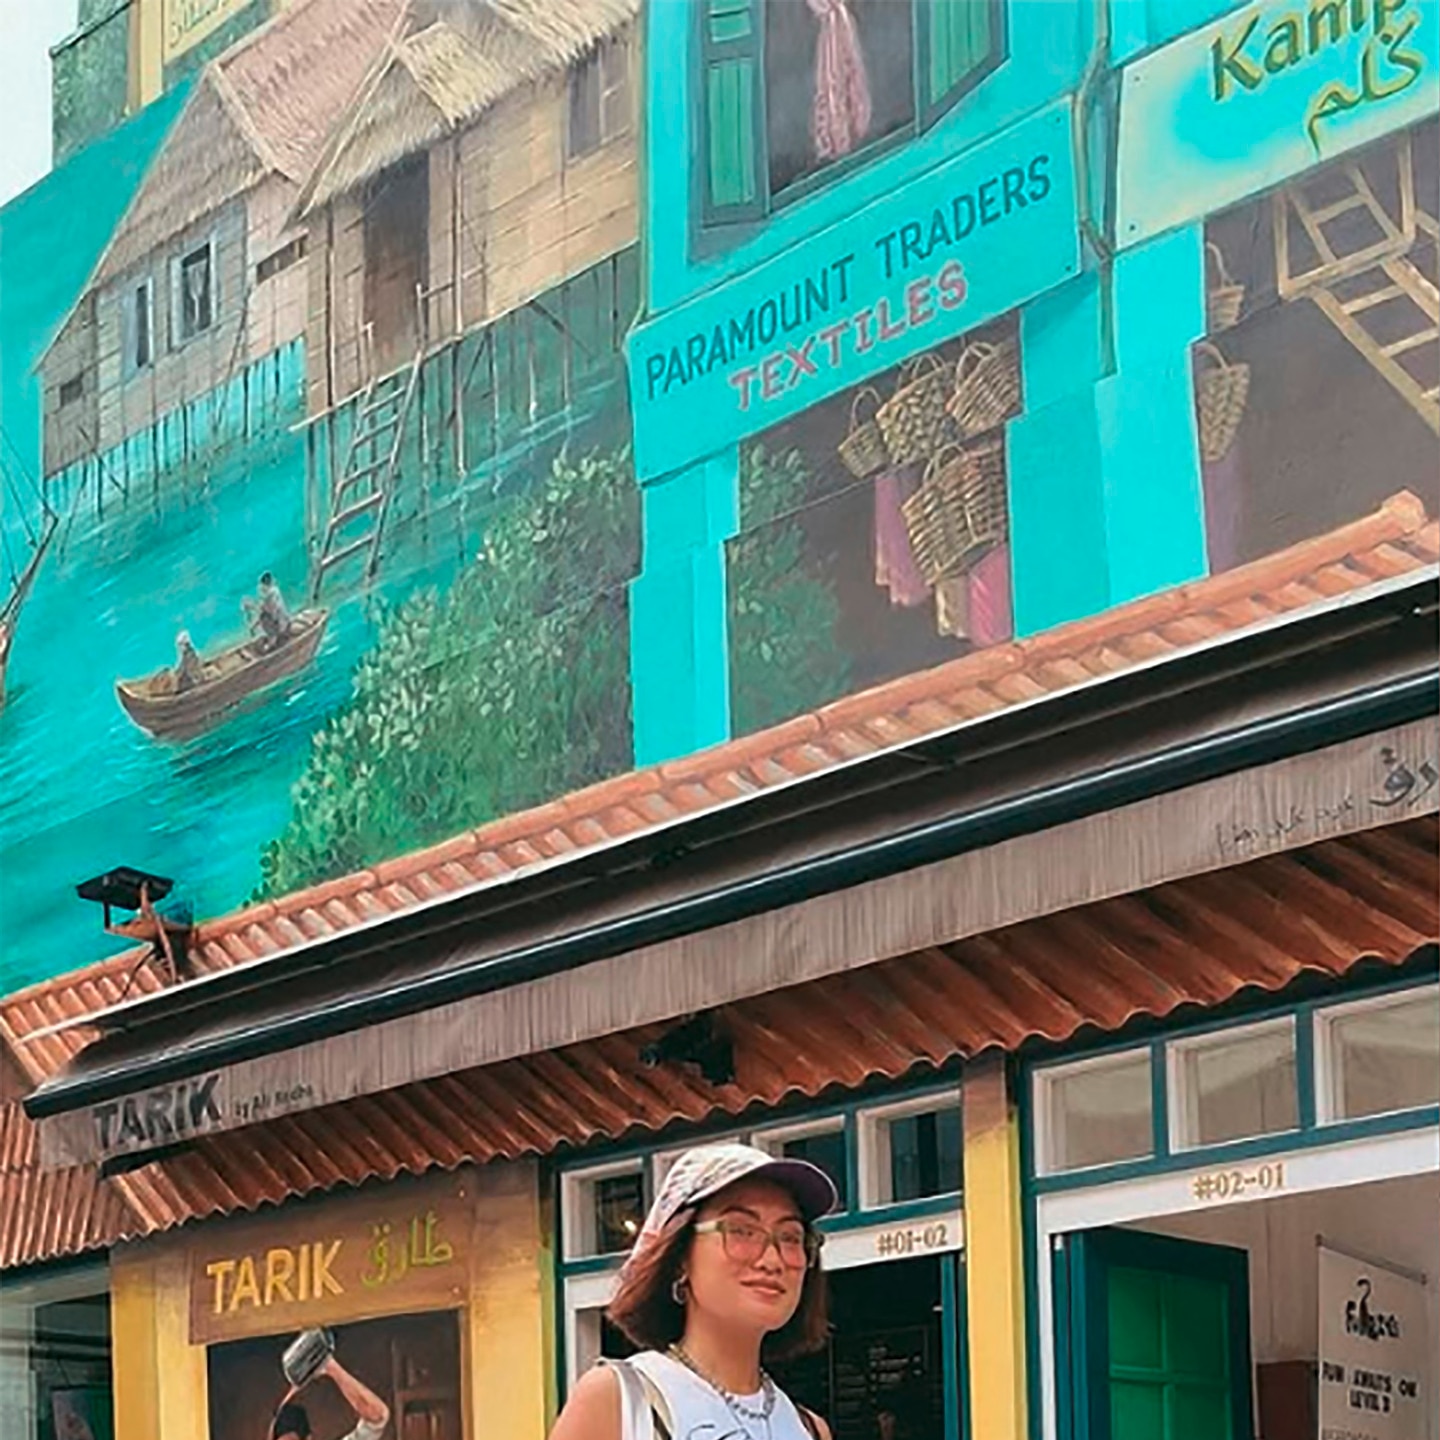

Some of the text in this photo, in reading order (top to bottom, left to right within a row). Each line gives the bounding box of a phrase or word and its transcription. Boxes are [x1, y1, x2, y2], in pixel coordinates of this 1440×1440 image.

[646, 153, 1052, 400] PARAMOUNT TRADERS
[728, 258, 970, 411] TEXTILES
[93, 1073, 223, 1150] TARIK
[1193, 1162, 1284, 1200] #02-01
[206, 1239, 345, 1314] TARIK
[360, 1210, 454, 1289] طارق
[877, 1223, 948, 1255] #01-02
